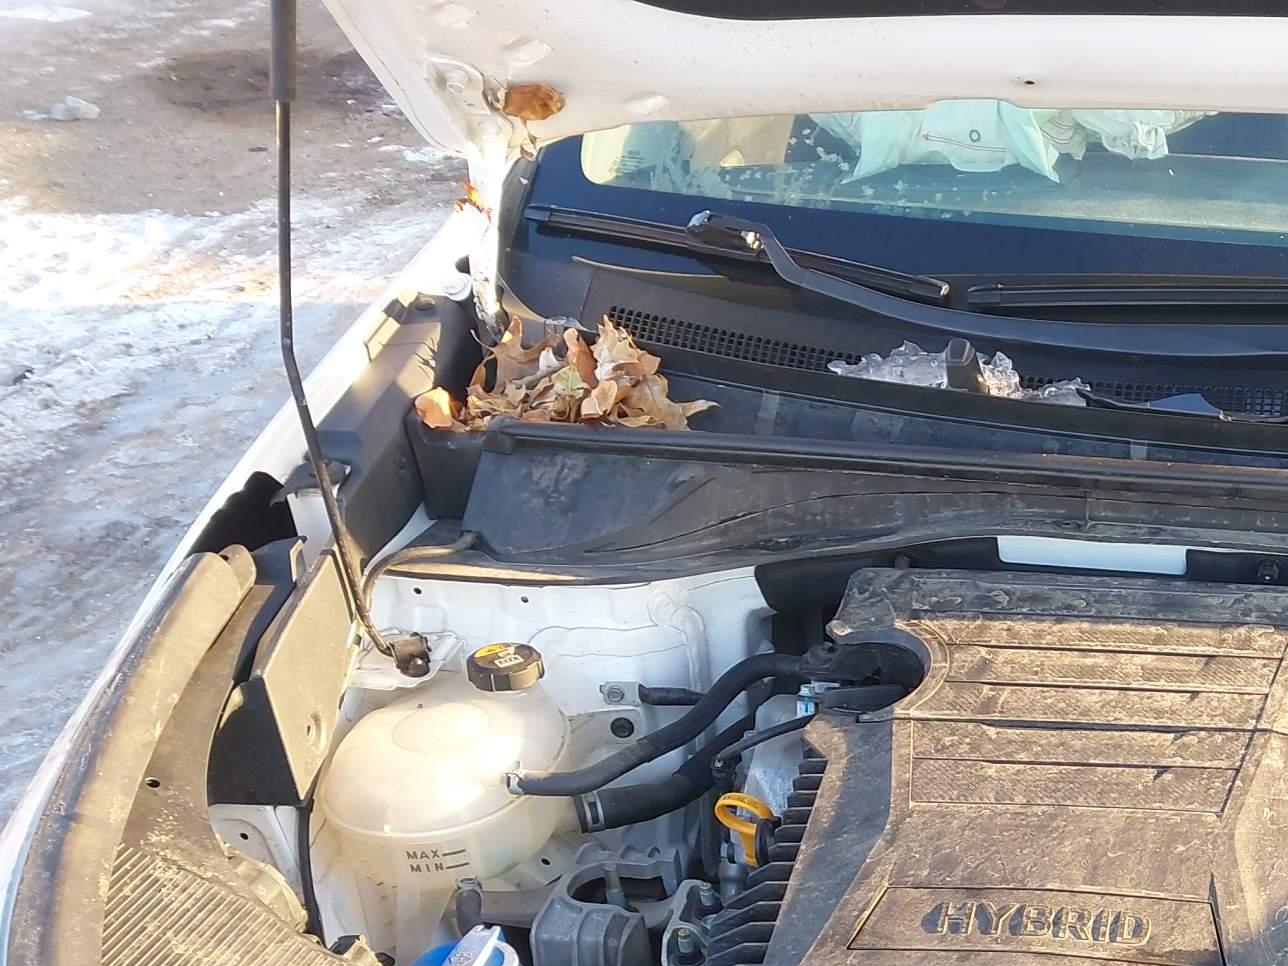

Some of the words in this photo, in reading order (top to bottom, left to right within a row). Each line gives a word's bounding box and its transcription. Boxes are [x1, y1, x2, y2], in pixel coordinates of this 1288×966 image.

[405, 848, 440, 860] MAX
[409, 862, 444, 873] MIN
[929, 901, 1152, 947] HYBRID
